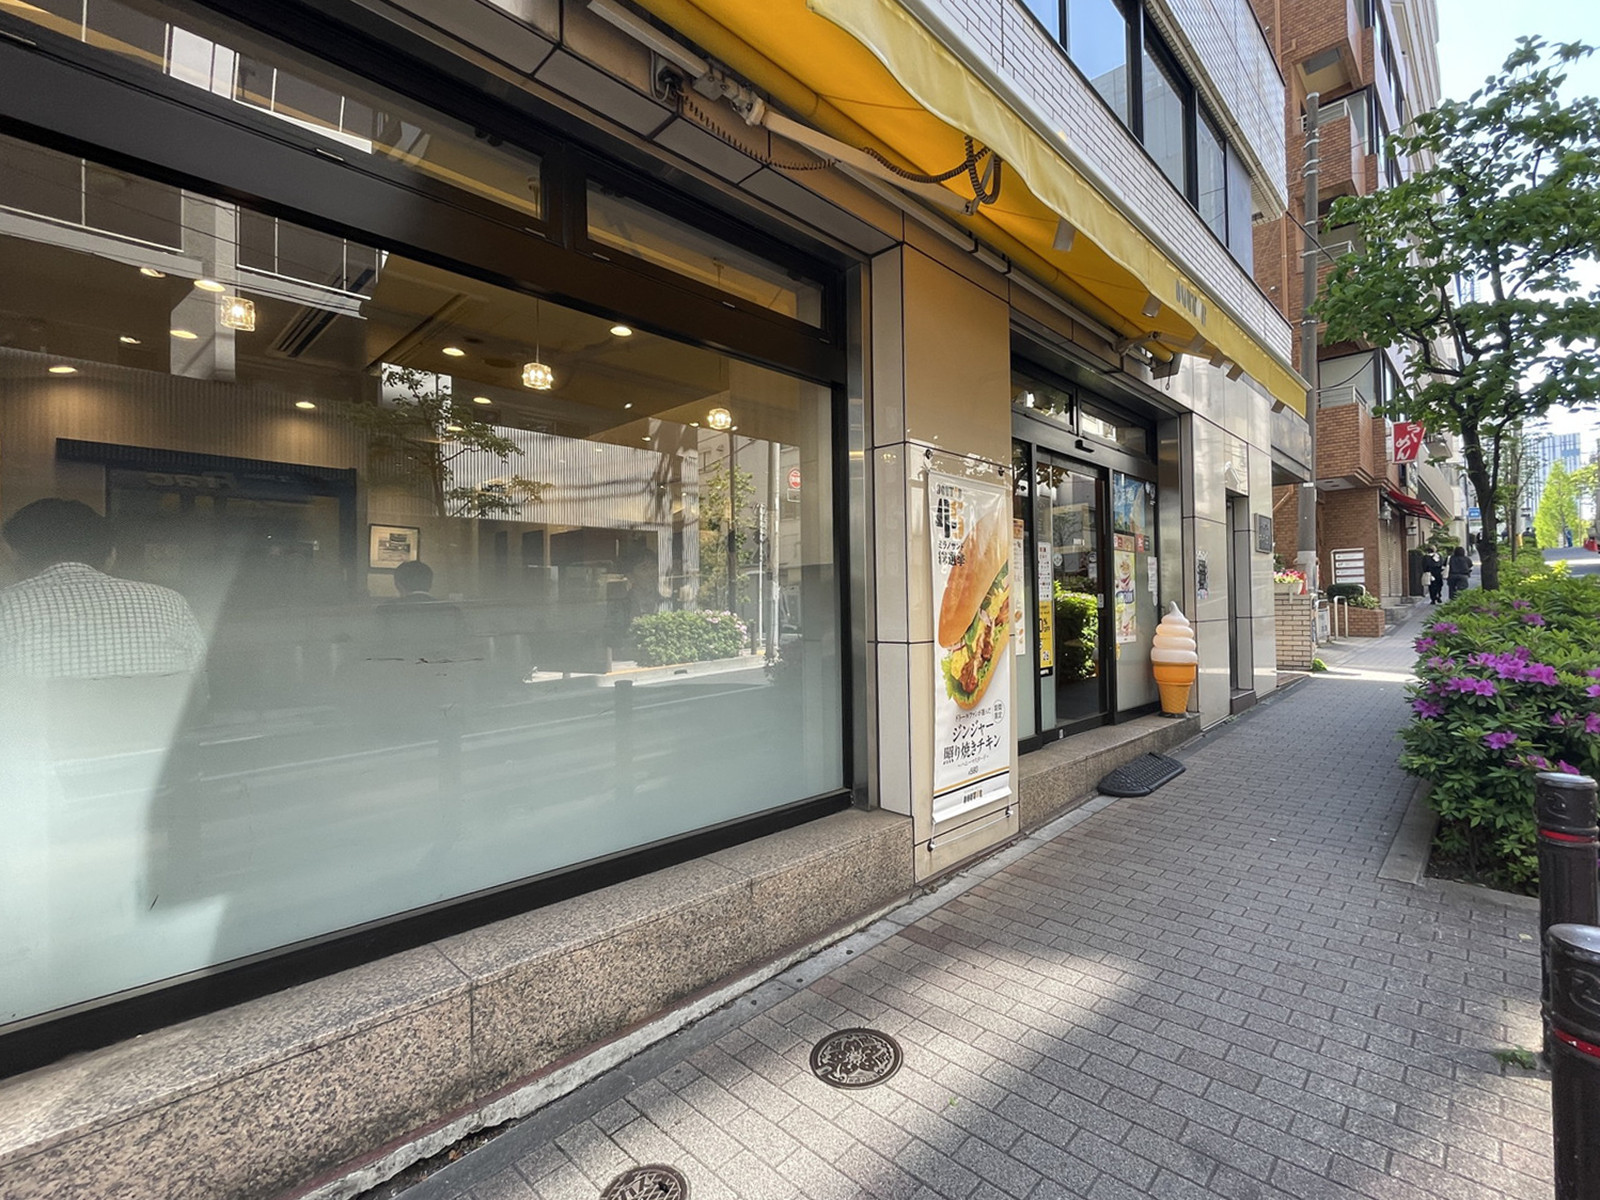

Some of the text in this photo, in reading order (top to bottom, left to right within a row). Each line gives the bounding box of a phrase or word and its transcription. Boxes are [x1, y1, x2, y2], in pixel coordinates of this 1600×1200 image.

[952, 720, 994, 742] ジンジャー
[943, 735, 1001, 765] 照り焼きチキン
